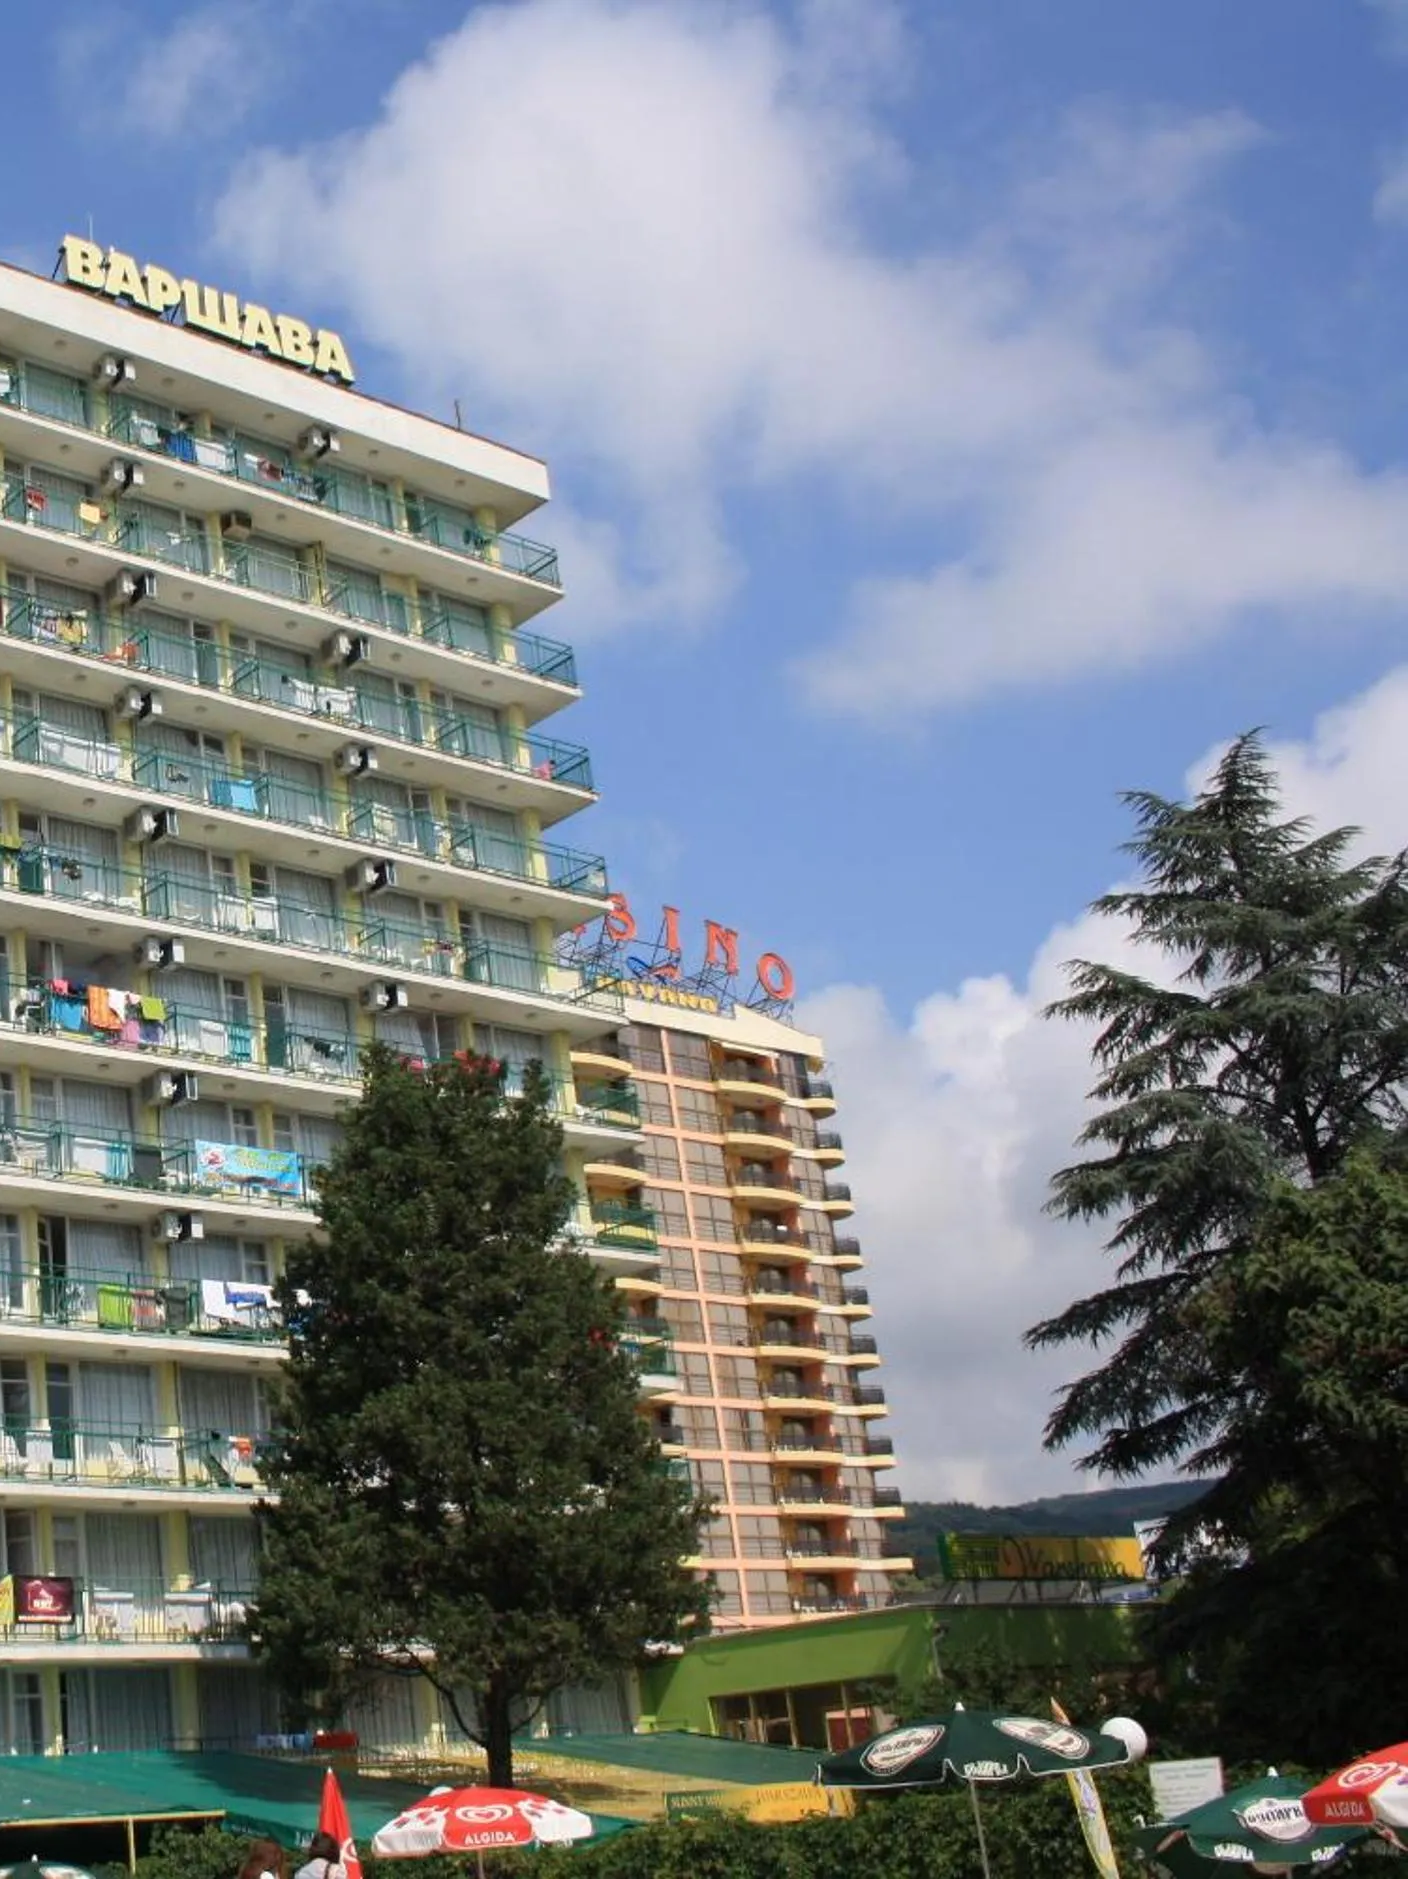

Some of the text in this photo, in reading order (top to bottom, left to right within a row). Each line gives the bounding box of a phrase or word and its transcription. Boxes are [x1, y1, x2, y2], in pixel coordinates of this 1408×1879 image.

[63, 234, 356, 383] ВАРШАВА
[573, 892, 796, 1001] SINO
[464, 1831, 516, 1845] ALGIDA
[1325, 1800, 1366, 1818] ALGIDA
